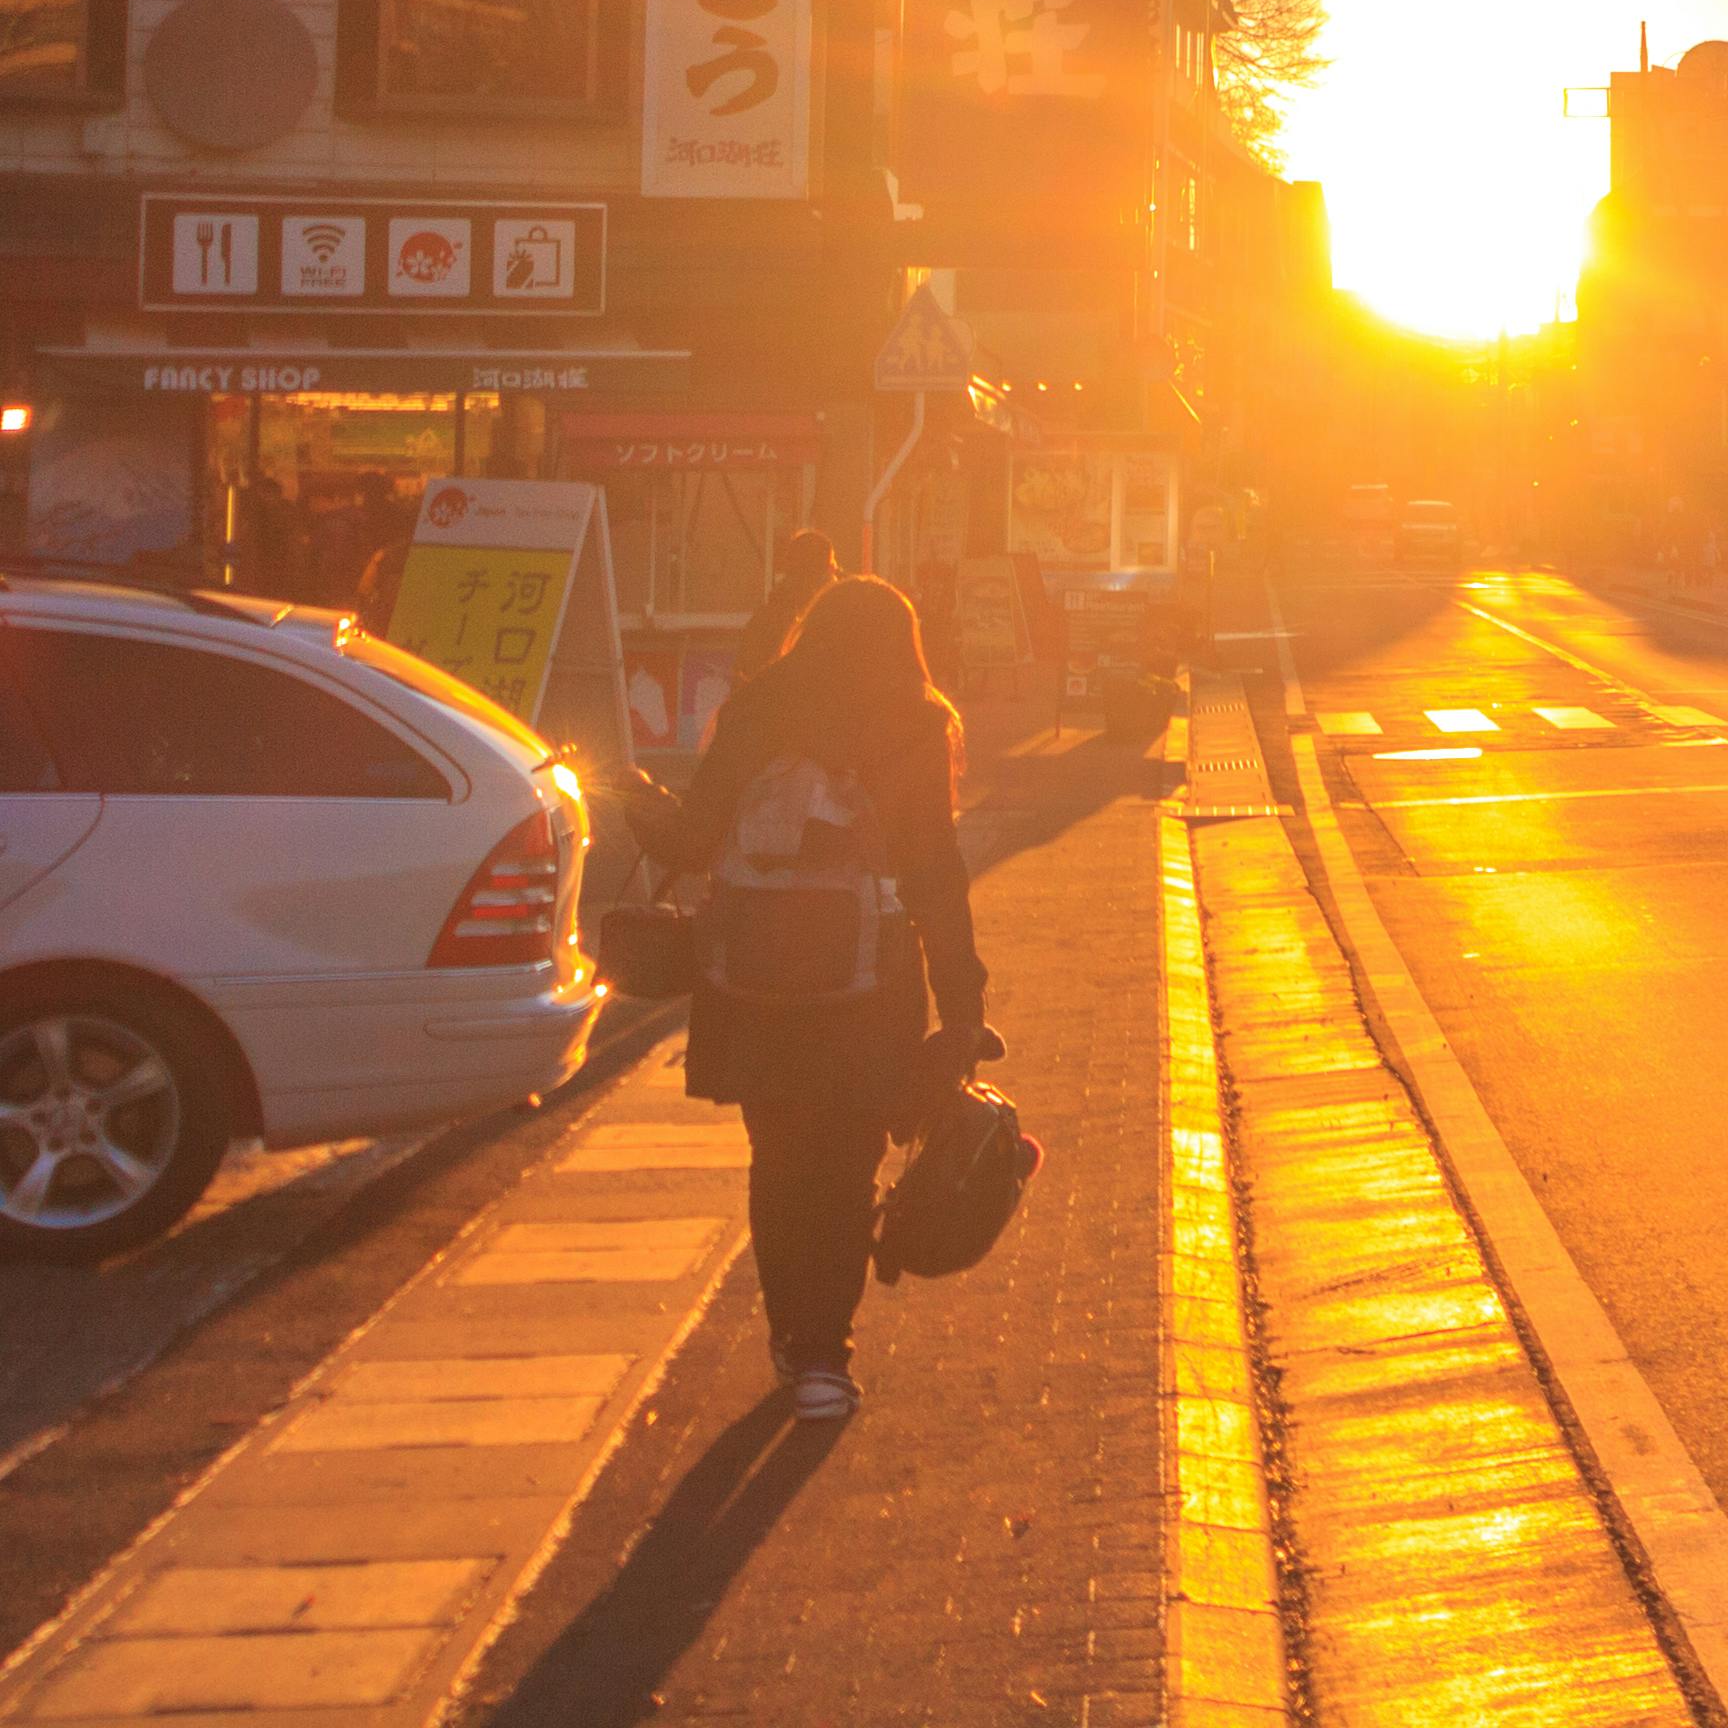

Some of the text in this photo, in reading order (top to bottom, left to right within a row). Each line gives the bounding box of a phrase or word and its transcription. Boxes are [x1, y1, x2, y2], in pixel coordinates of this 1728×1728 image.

[143, 365, 321, 391] FANCY SHOP
[615, 441, 779, 465] ソフトクリーム
